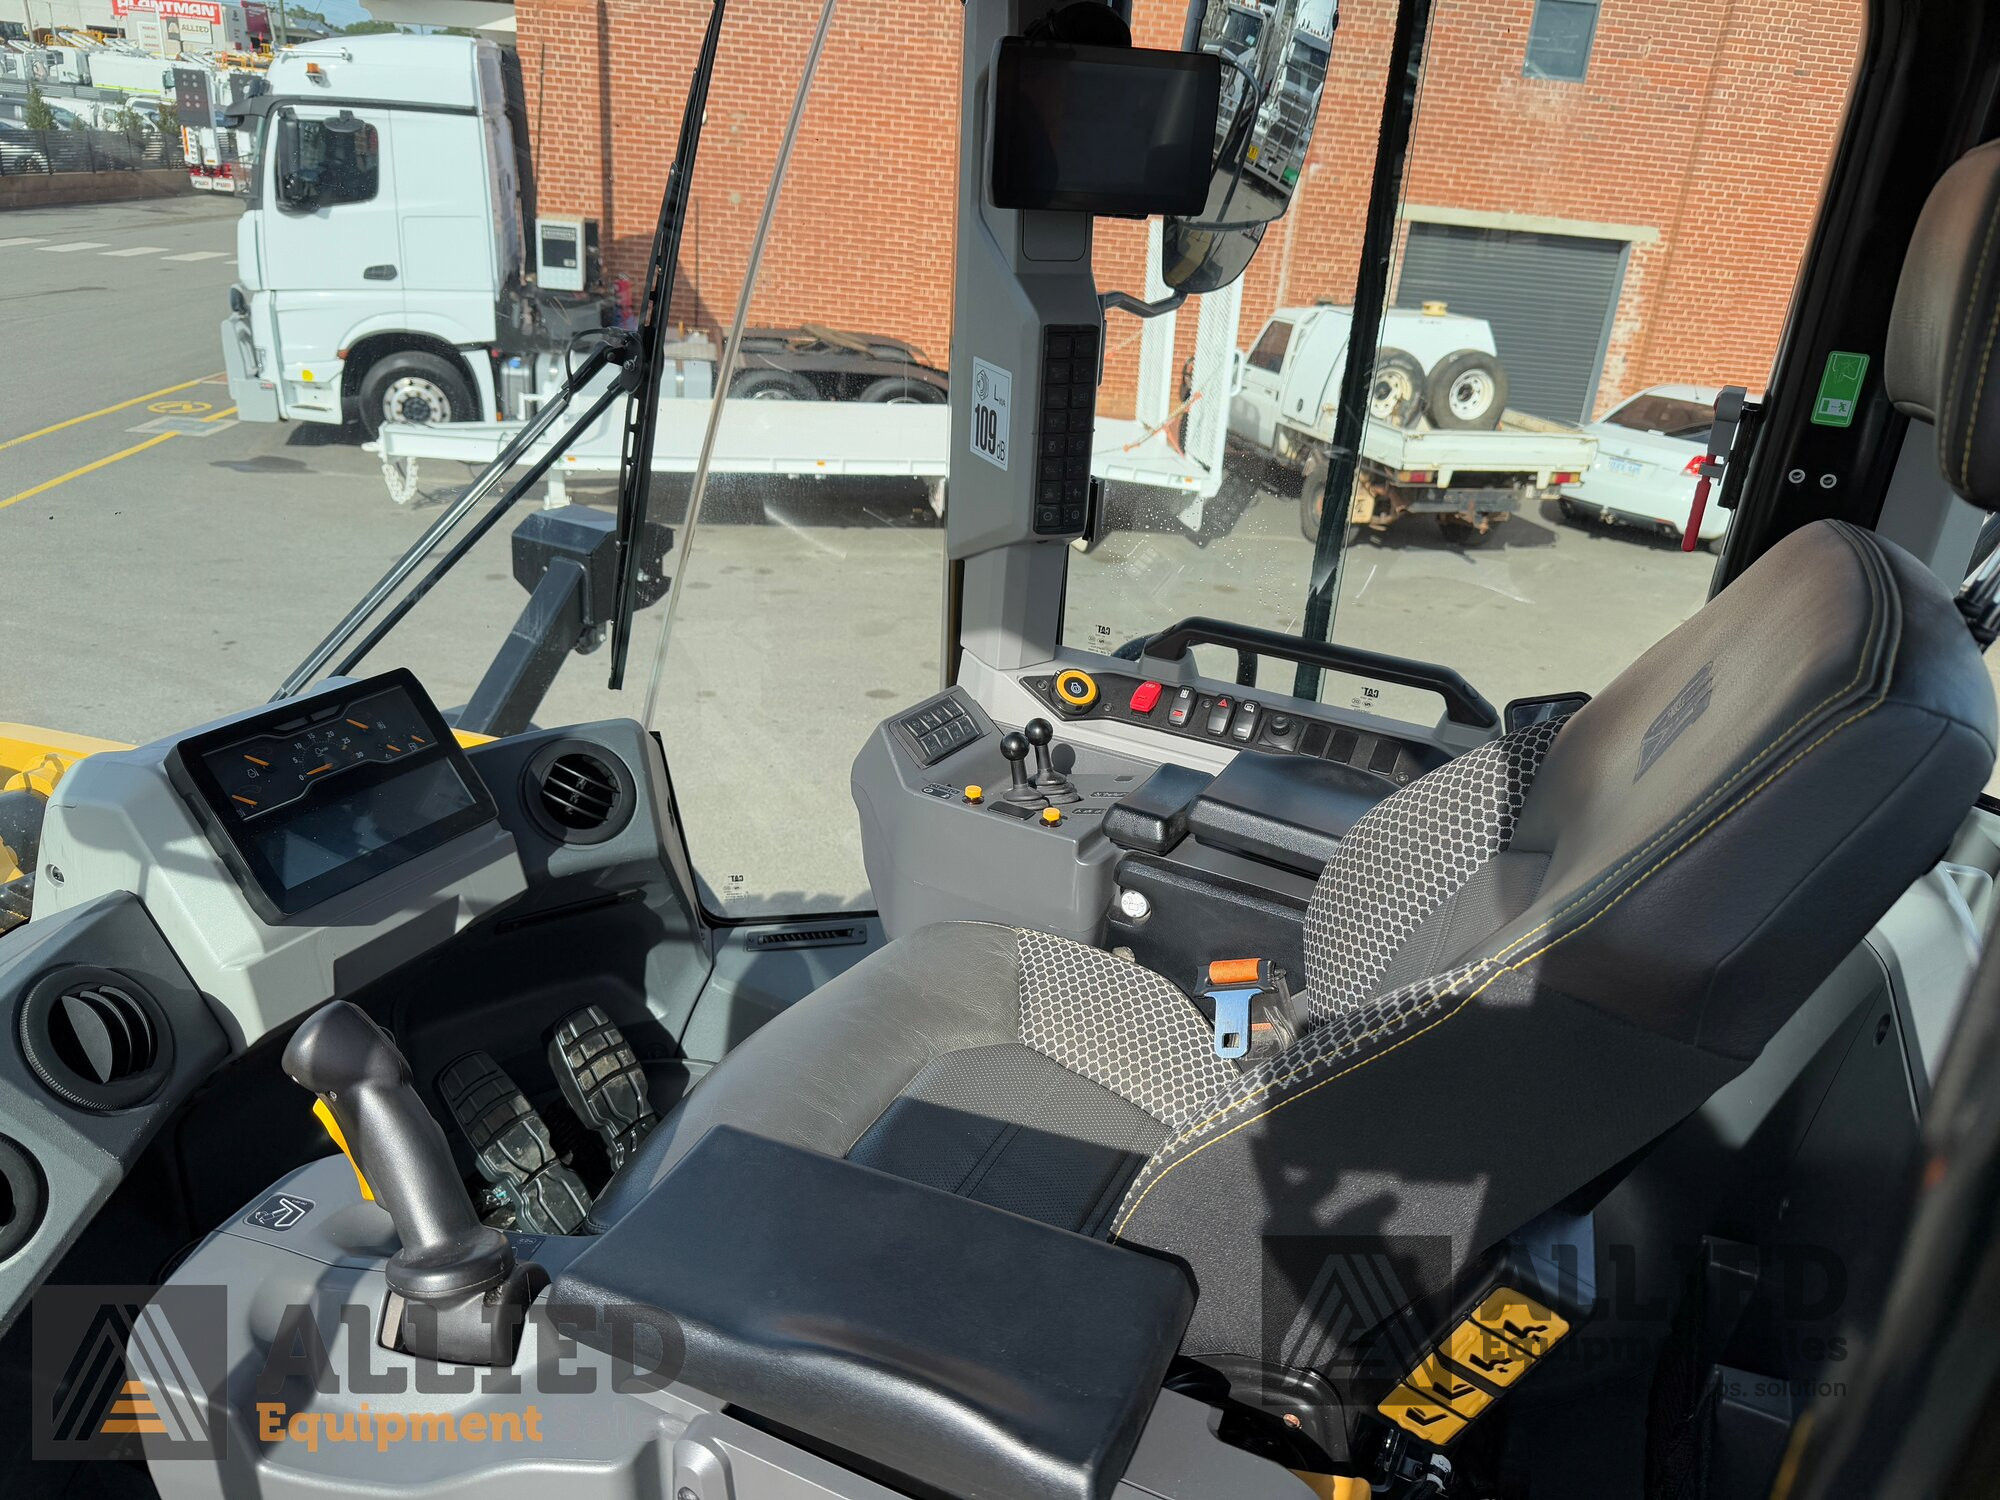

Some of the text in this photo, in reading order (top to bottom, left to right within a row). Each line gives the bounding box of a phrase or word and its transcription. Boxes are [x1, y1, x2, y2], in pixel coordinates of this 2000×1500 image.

[117, 0, 215, 16] PLANTMAN
[181, 24, 209, 33] ALLIED
[975, 403, 997, 455] 109
[307, 732, 315, 740] 15
[326, 730, 335, 738] 20
[294, 742, 302, 750] 10
